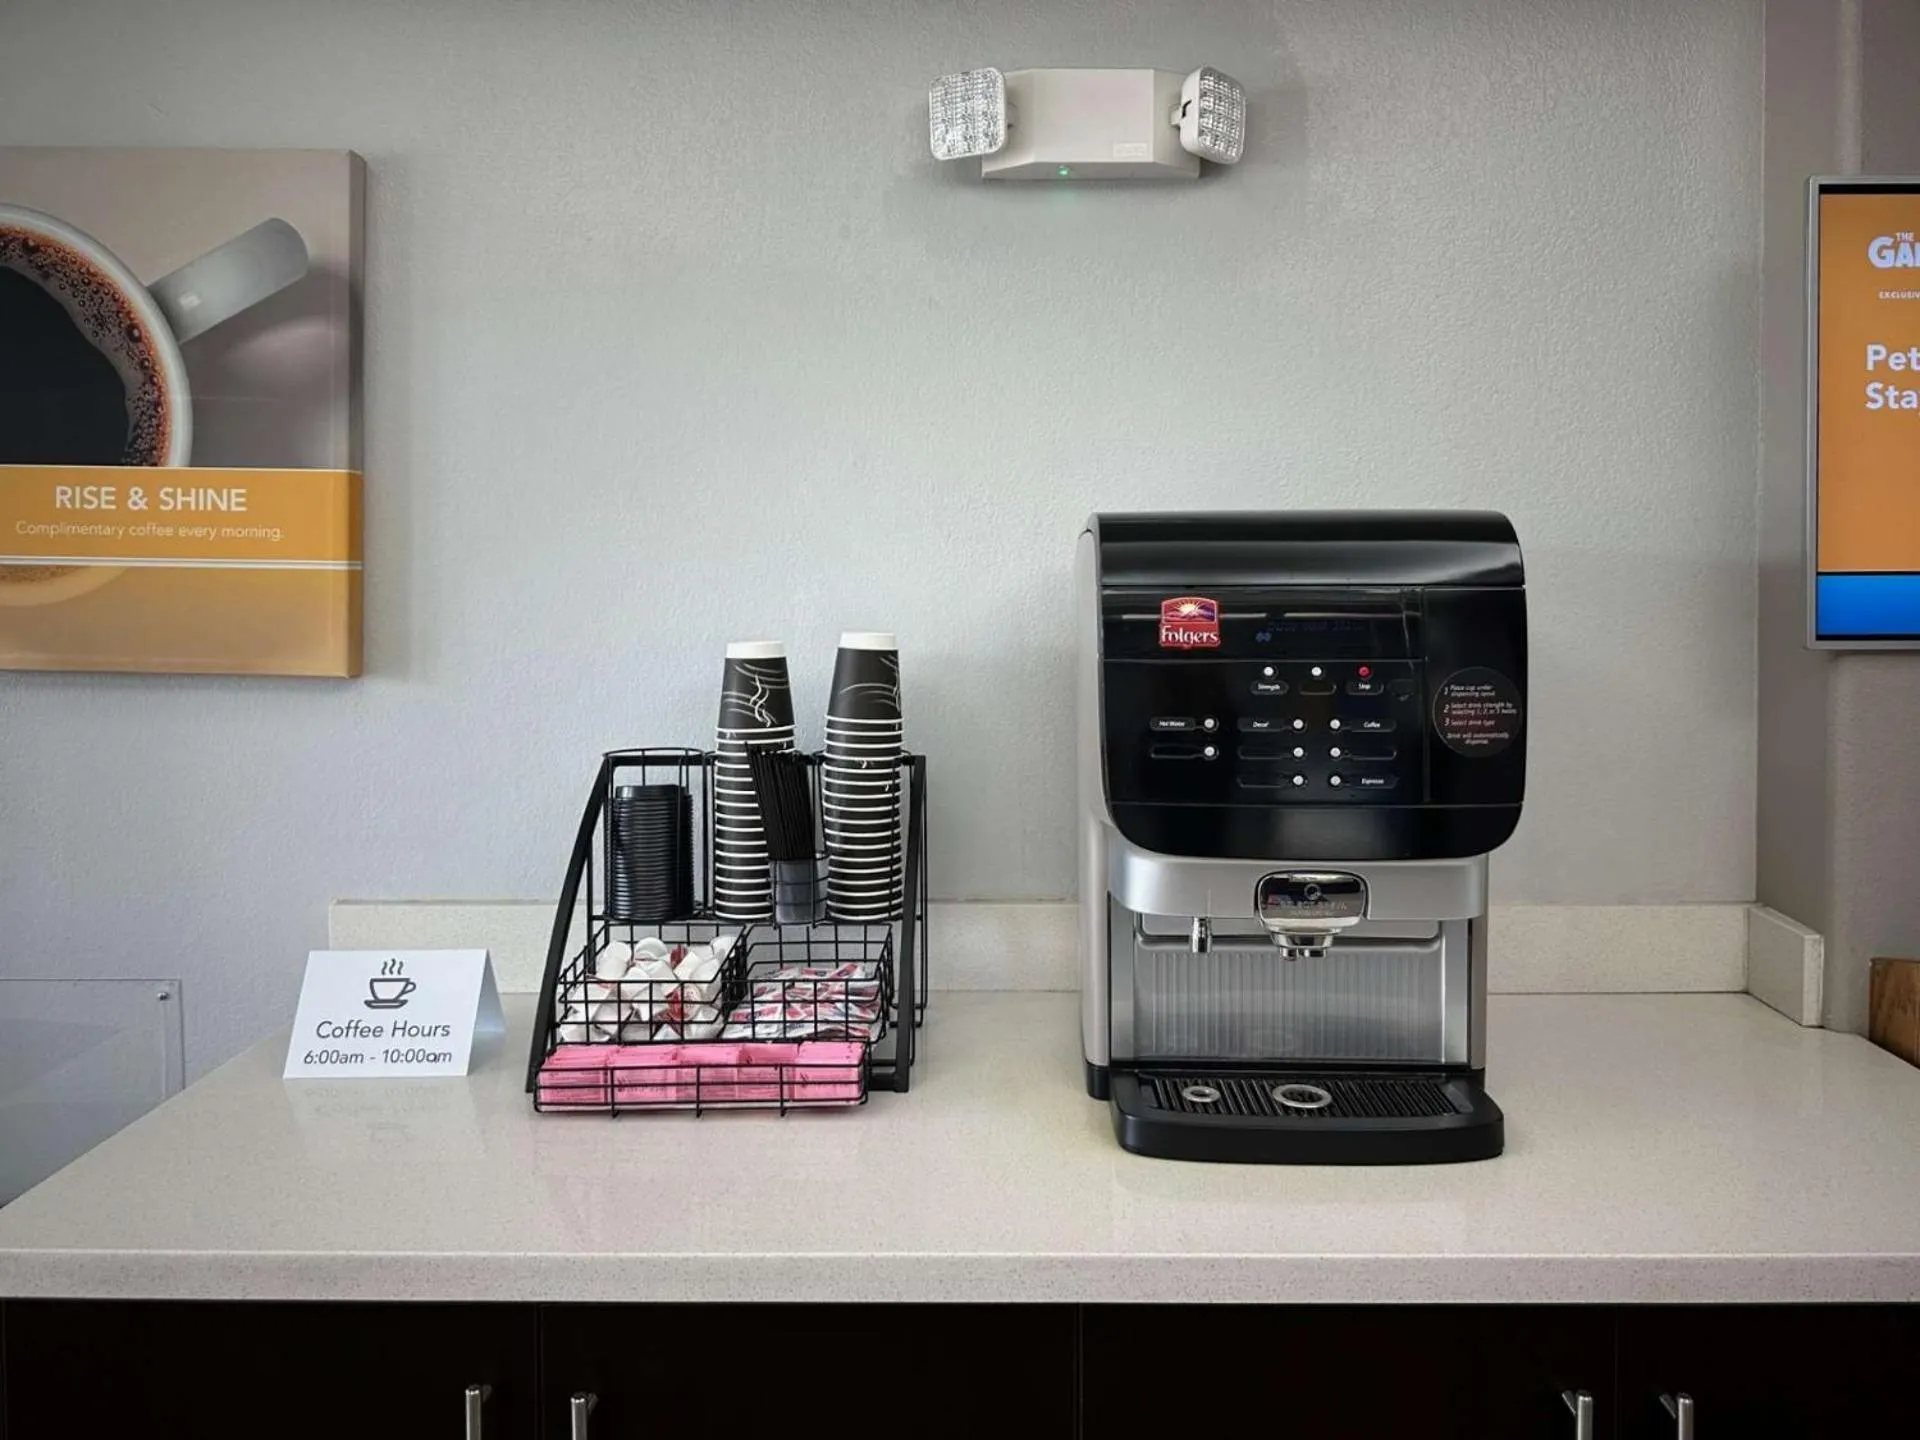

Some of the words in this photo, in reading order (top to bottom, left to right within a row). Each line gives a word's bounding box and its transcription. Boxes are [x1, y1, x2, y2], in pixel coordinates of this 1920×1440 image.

[1896, 232, 1914, 241] THE
[1867, 344, 1920, 371] Pet
[1866, 382, 1920, 413] Sta
[55, 485, 117, 510] RISE
[127, 486, 149, 511] &
[159, 487, 248, 512] SHINE
[15, 520, 124, 539] Complimentary
[129, 522, 174, 538] coffee
[178, 527, 217, 541] every
[221, 525, 285, 541] morning.
[1162, 625, 1218, 644] Folgers
[1361, 777, 1384, 785] Espresso
[316, 1020, 384, 1039] Coffee
[391, 1020, 450, 1038] Hours
[303, 1049, 364, 1065] 6:00am
[383, 1049, 452, 1064] 10:00am
